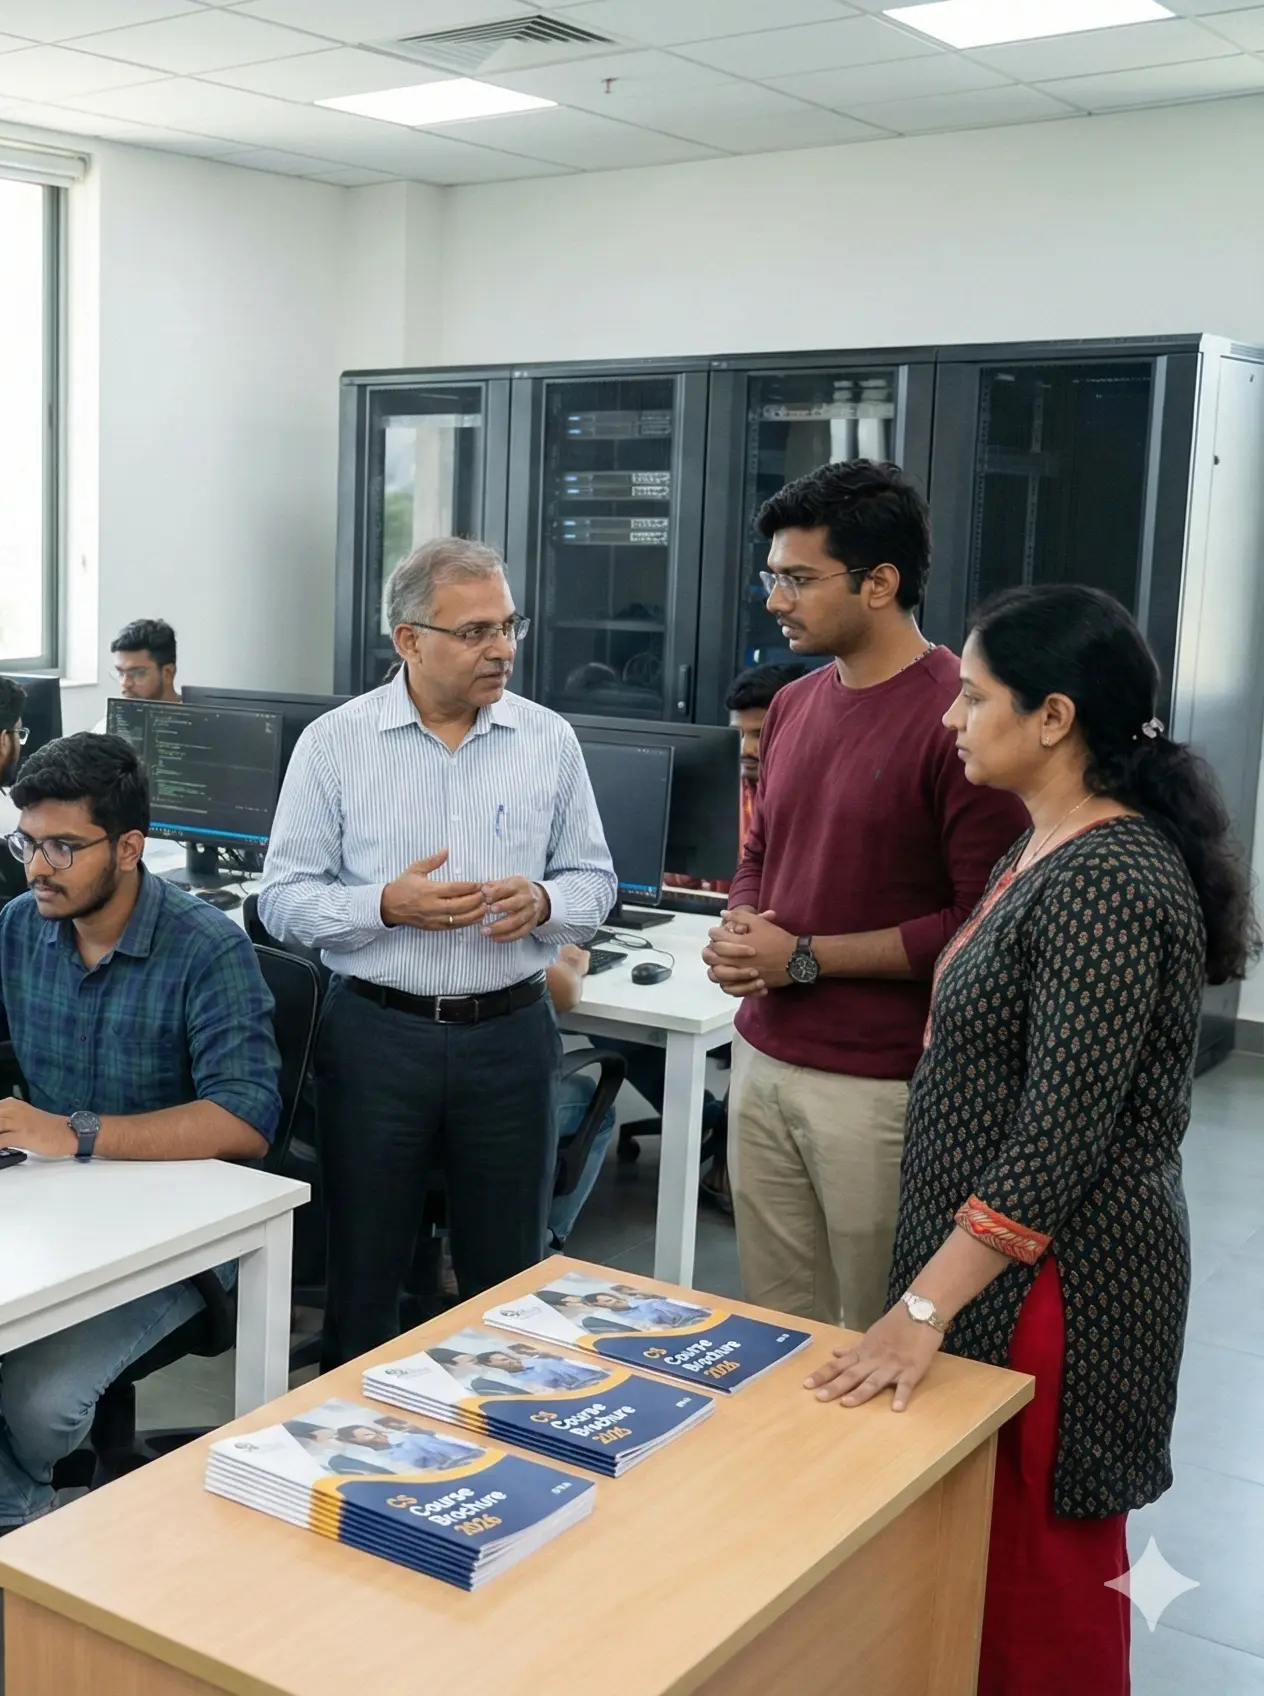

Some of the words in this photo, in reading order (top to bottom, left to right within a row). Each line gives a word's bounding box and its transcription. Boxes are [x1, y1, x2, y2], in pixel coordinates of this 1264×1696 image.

[386, 1494, 418, 1508] CS
[409, 1487, 475, 1517] Course
[428, 1490, 507, 1526] Brochure
[454, 1513, 503, 1536] 2026
